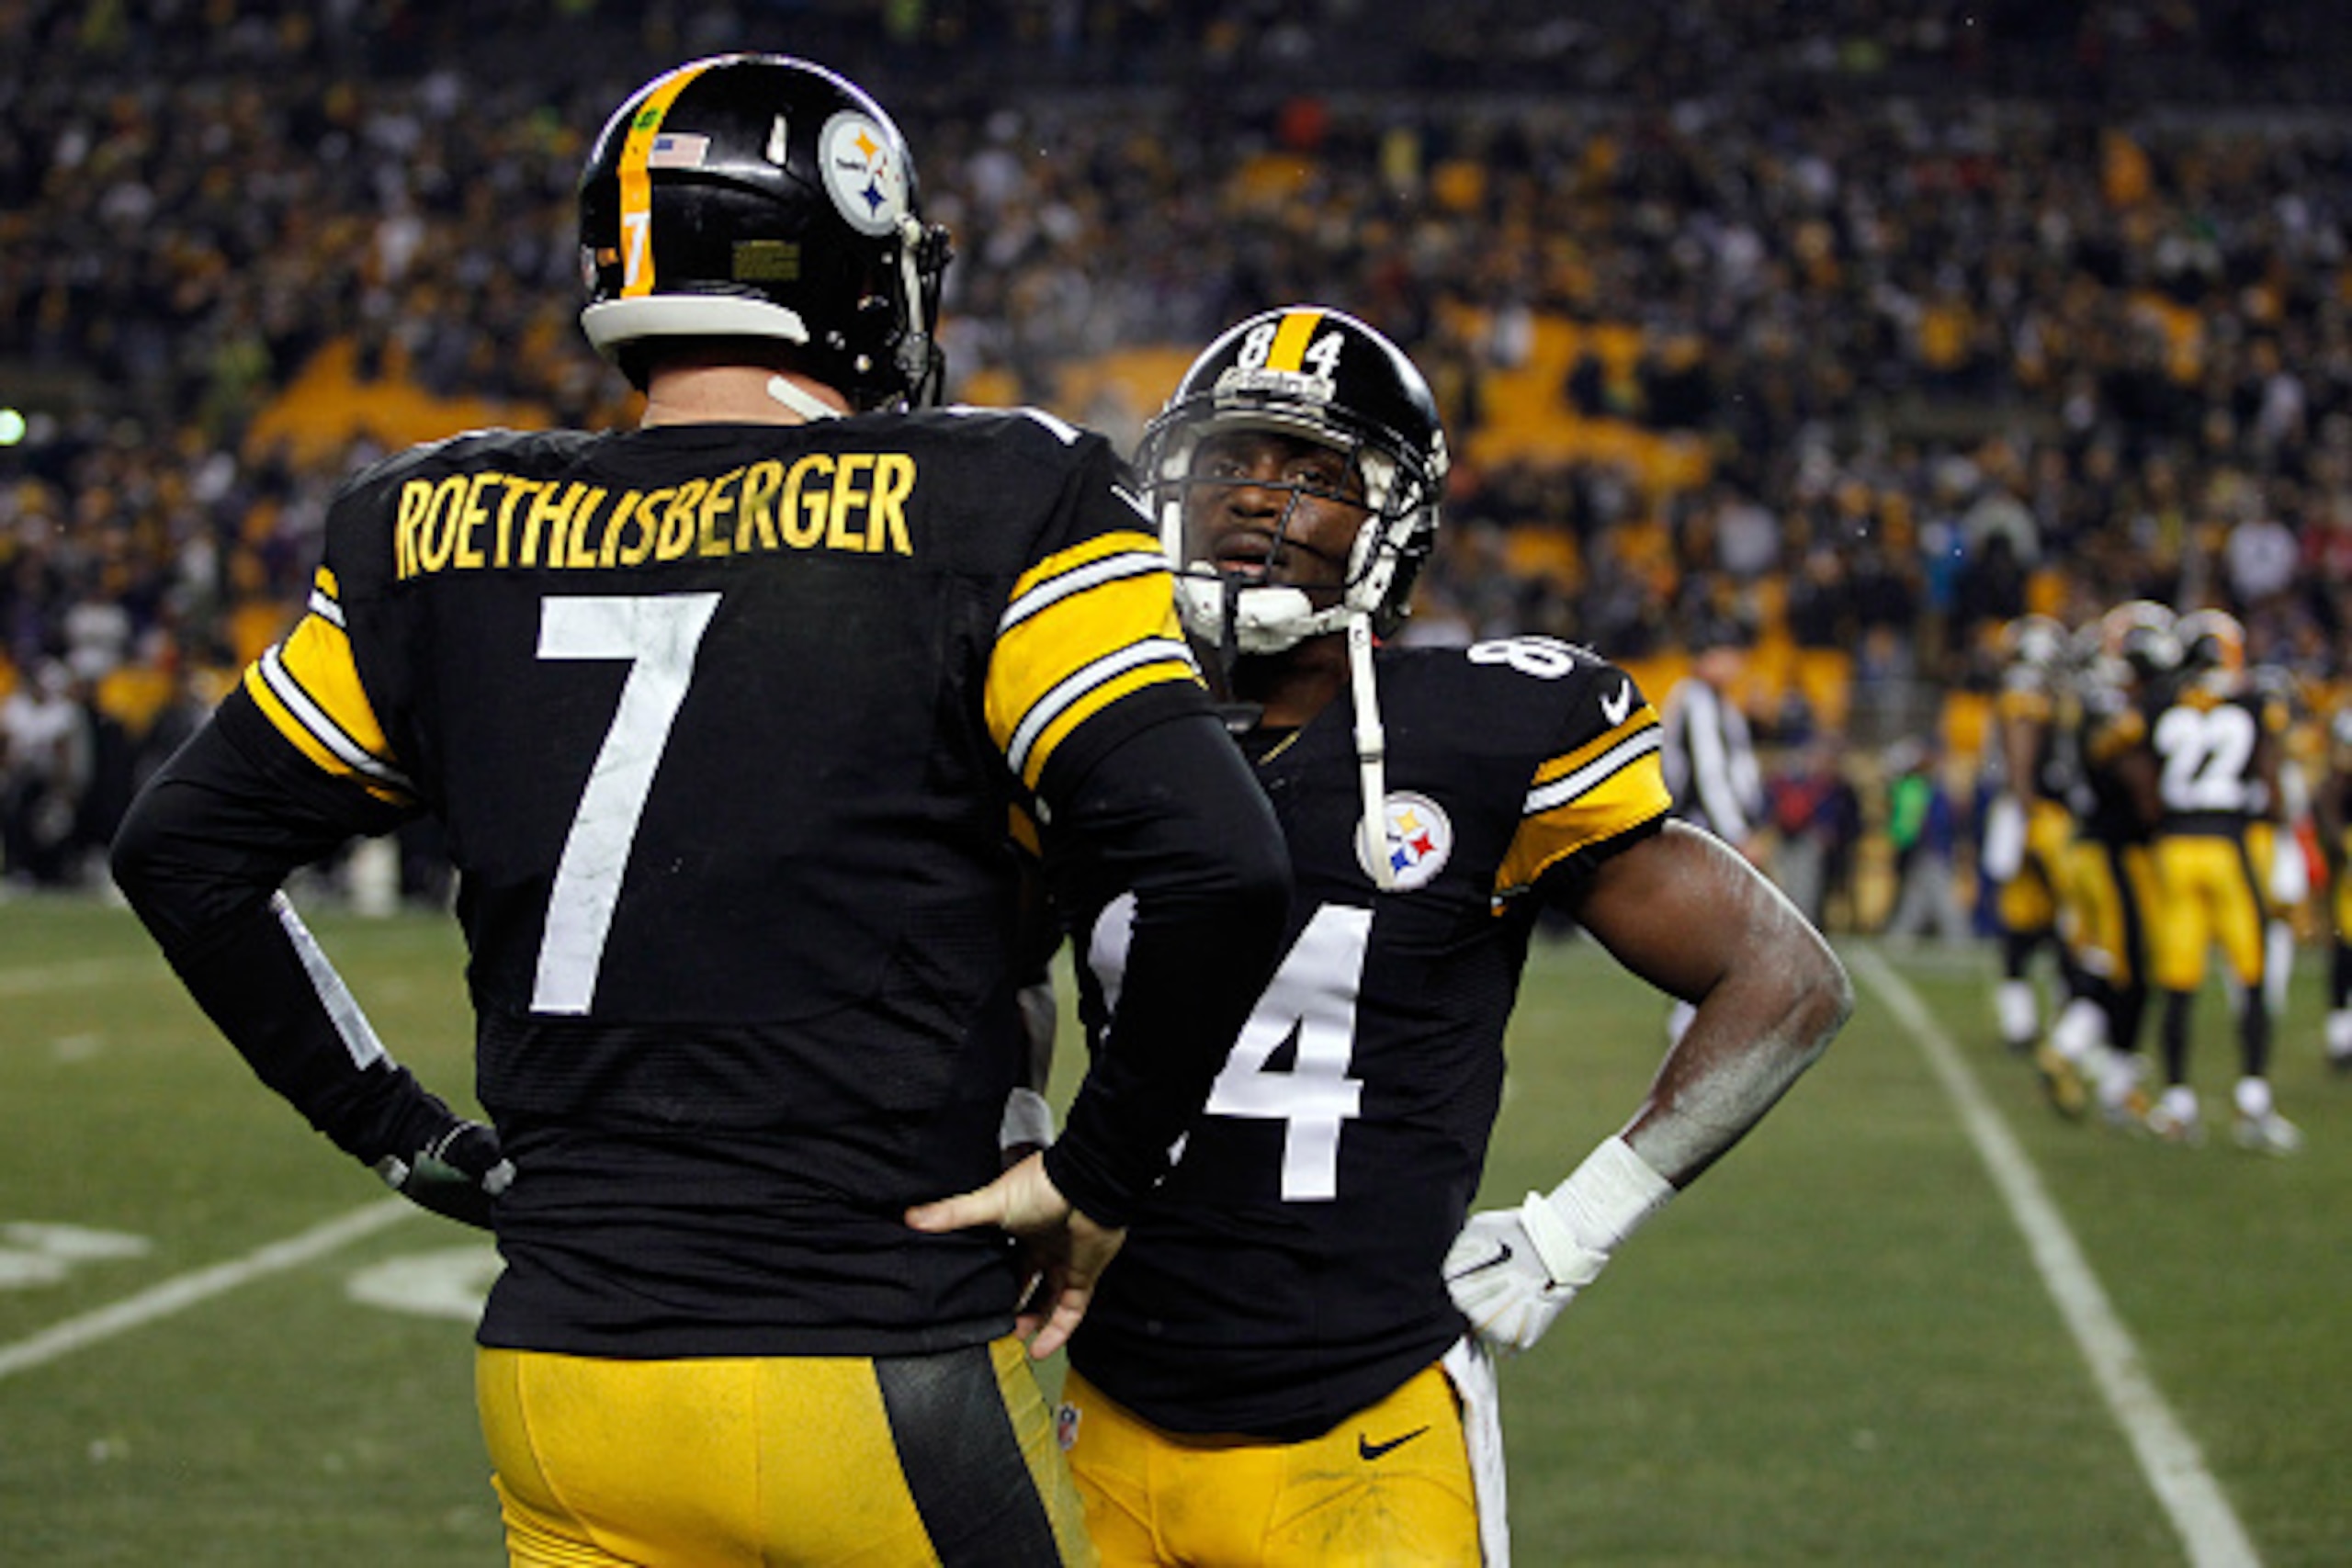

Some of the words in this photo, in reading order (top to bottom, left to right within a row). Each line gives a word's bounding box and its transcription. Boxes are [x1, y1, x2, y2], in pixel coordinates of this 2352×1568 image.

[625, 212, 651, 287] 7
[396, 454, 915, 580] ROETHLISBERGER
[529, 592, 722, 1015] 7
[2154, 705, 2255, 810] 22
